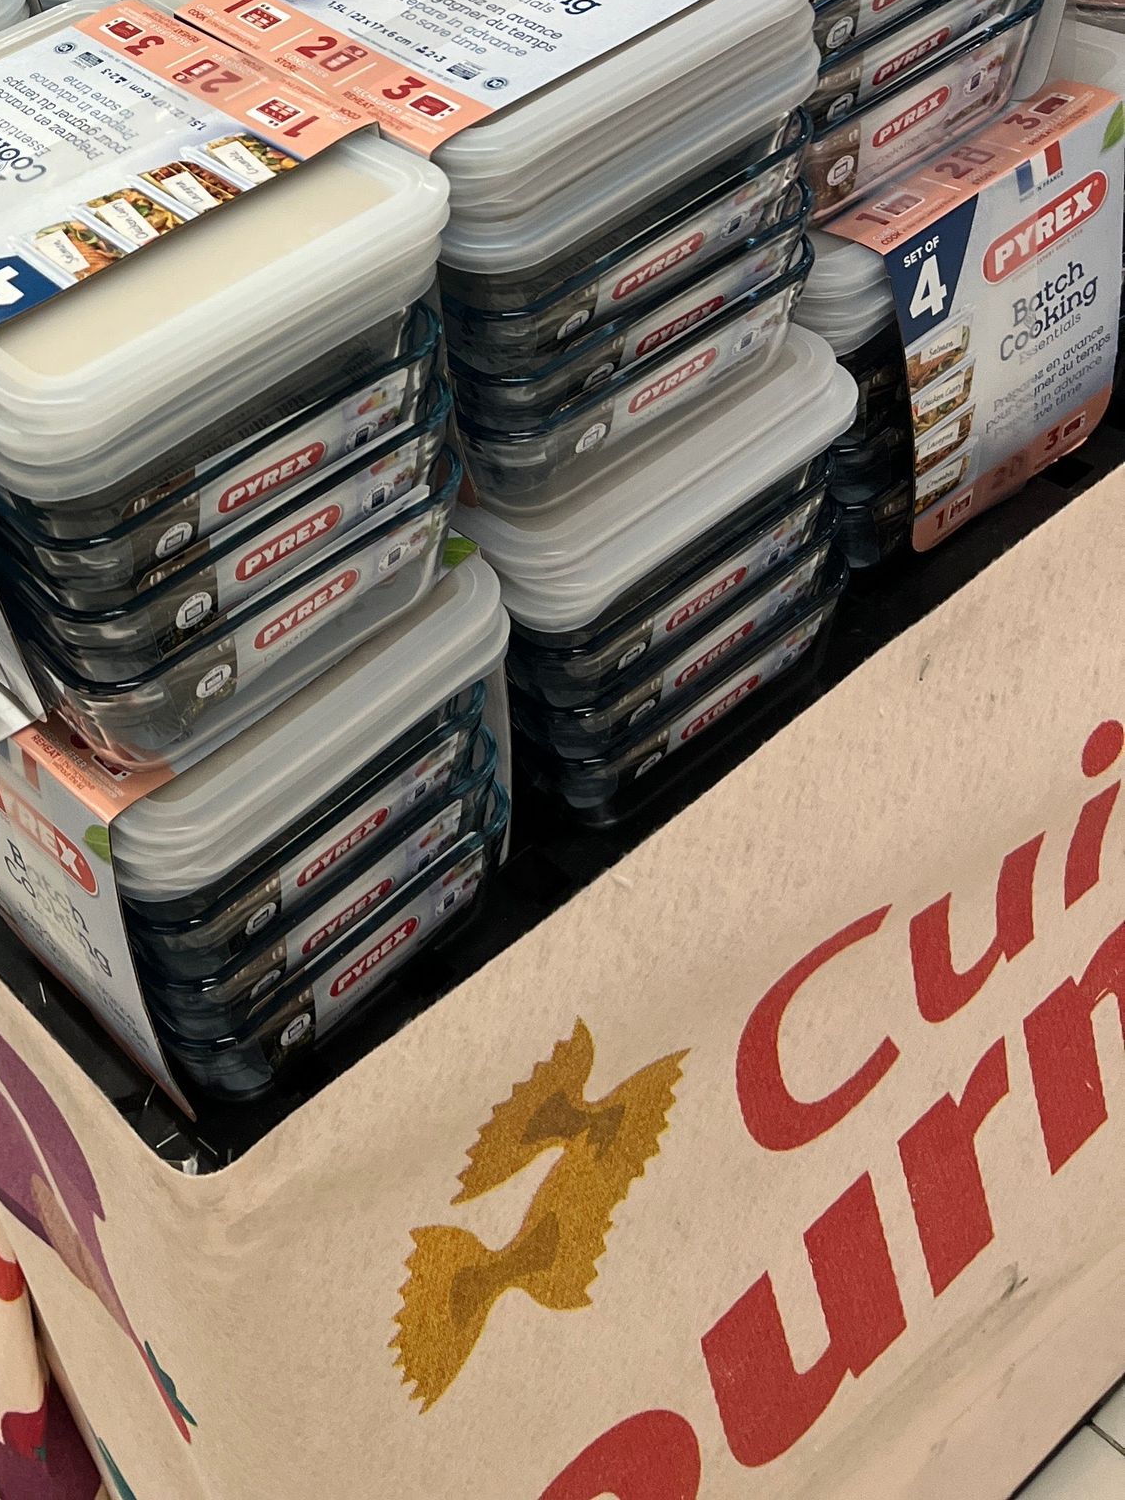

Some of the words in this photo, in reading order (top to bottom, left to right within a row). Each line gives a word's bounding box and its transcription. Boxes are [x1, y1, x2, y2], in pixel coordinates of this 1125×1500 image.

[187, 8, 208, 22] COOK
[400, 9, 416, 24] to
[413, 18, 451, 42] save
[451, 31, 488, 56] time
[448, 13, 462, 28] in
[464, 20, 527, 57] advance
[486, 13, 506, 30] du
[506, 25, 557, 54] temps
[487, 0, 506, 13] en
[506, 11, 563, 40] avance
[295, 36, 338, 60] 2
[382, 76, 427, 100] 3
[877, 94, 941, 142] PYREX
[903, 248, 924, 268] SET
[925, 236, 940, 254] OF
[994, 184, 1094, 275] PYREX
[616, 235, 701, 298] PYREX
[909, 254, 947, 320] 4
[1012, 260, 1084, 328] Batch
[1000, 276, 1098, 362] Cooking
[633, 351, 716, 412] PYREX
[225, 446, 316, 512] PYREX
[335, 920, 414, 994] PYREX
